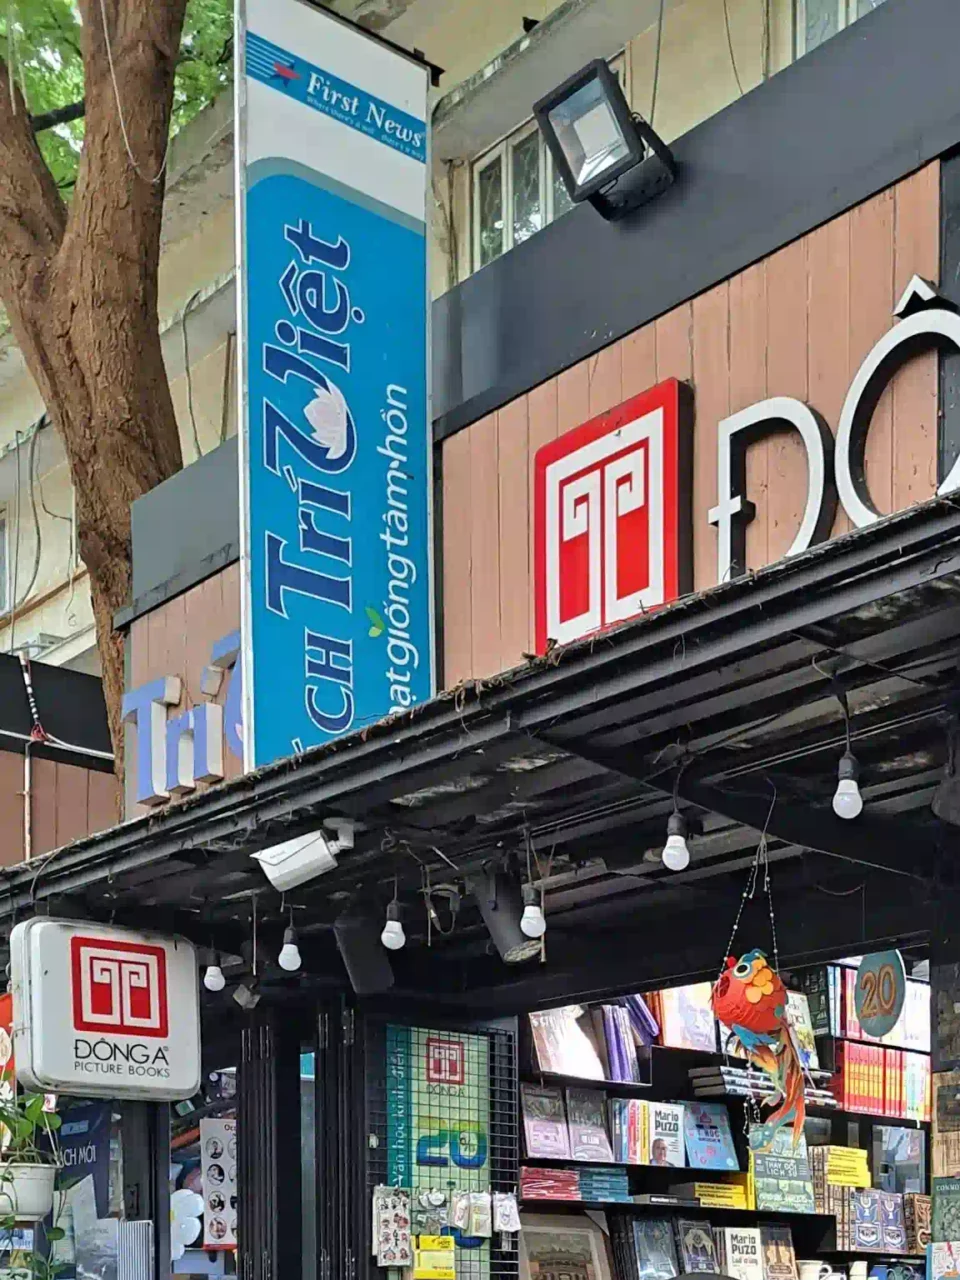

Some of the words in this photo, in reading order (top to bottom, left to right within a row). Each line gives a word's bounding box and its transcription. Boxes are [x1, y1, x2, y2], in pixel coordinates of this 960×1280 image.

[307, 72, 359, 115] First
[365, 102, 422, 148] News
[264, 464, 353, 619] Trí
[860, 964, 897, 1019] 20
[74, 1061, 123, 1075] PICTURE
[128, 1065, 171, 1078] BOOKS
[655, 1110, 679, 1122] Mario
[731, 1234, 756, 1245] Mario
